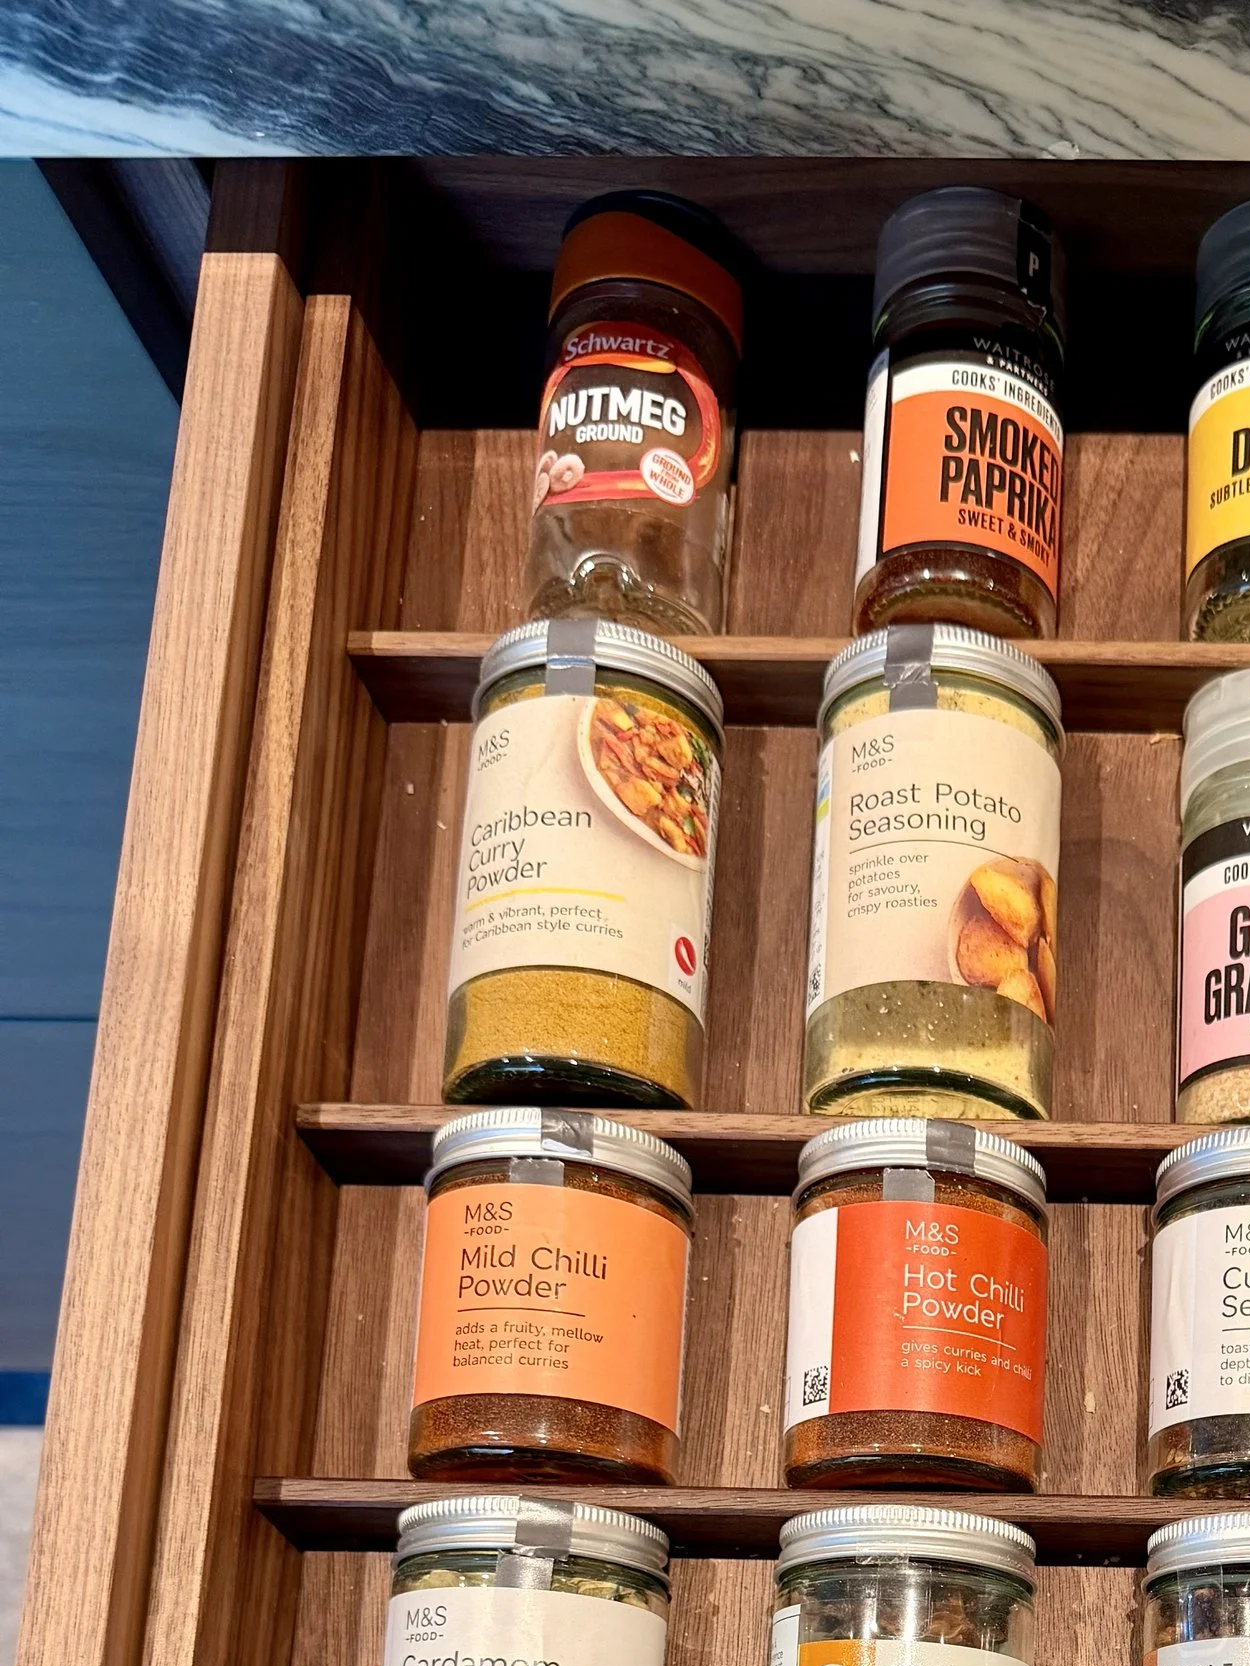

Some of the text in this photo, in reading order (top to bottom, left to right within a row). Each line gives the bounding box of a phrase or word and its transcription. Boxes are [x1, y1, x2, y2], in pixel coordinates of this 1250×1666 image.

[565, 333, 669, 361] Schwartz
[952, 369, 1001, 391] COOKS'
[1210, 365, 1250, 400] COOKS'
[549, 387, 686, 437] NUTMEG
[576, 424, 643, 444] GROUND
[652, 453, 691, 485] GROUND
[944, 406, 1059, 504] SMOKED
[650, 471, 685, 498] WHOLE
[940, 455, 1056, 558] PAPRIKA
[958, 509, 1050, 568] SWEET & SMOKY
[476, 729, 510, 761] M&S
[851, 734, 895, 763] M&S
[849, 782, 1021, 825] Roast Potato
[471, 805, 592, 847] Caribbean
[849, 811, 986, 842] Seasoning
[468, 839, 525, 875] Curry
[849, 853, 929, 876] sprinkle over
[466, 858, 547, 899] Powder
[848, 868, 901, 890] potatoes
[500, 904, 602, 921] vibrant, perfect
[475, 919, 624, 942] Caribbean style curries
[677, 976, 692, 994] mild
[464, 1201, 513, 1224] M&S
[905, 1220, 959, 1244] M&S
[461, 1244, 608, 1280] Mild Chilli
[458, 1274, 566, 1299] Powder
[904, 1264, 1024, 1313] Hot Chilli
[903, 1292, 1004, 1330] Powder
[406, 1605, 447, 1630] M&S
